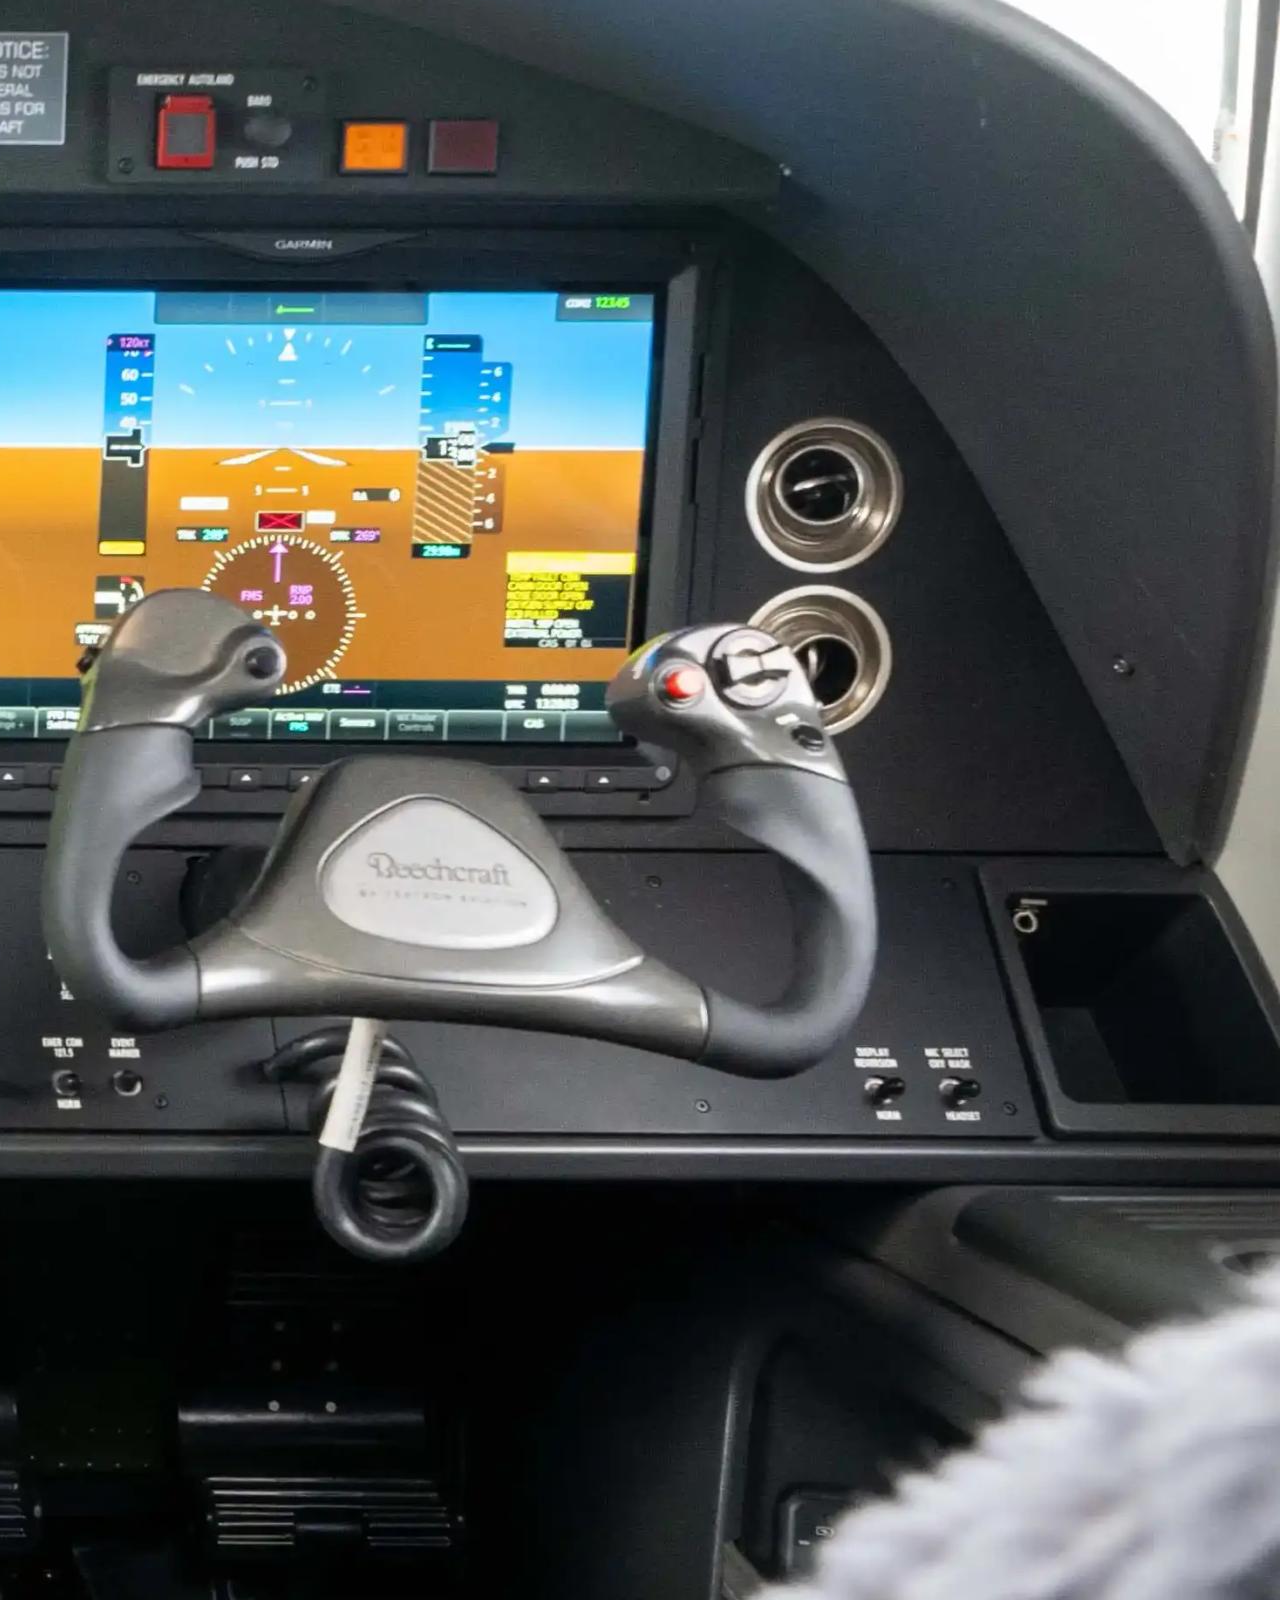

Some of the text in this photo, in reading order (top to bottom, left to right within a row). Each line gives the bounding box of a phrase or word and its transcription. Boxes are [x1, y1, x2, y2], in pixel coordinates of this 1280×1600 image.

[12, 64, 42, 78] NOT
[137, 73, 234, 86] EMERGENCY AUTOLAND
[14, 101, 45, 115] FOR
[368, 852, 510, 885] Beechcraft
